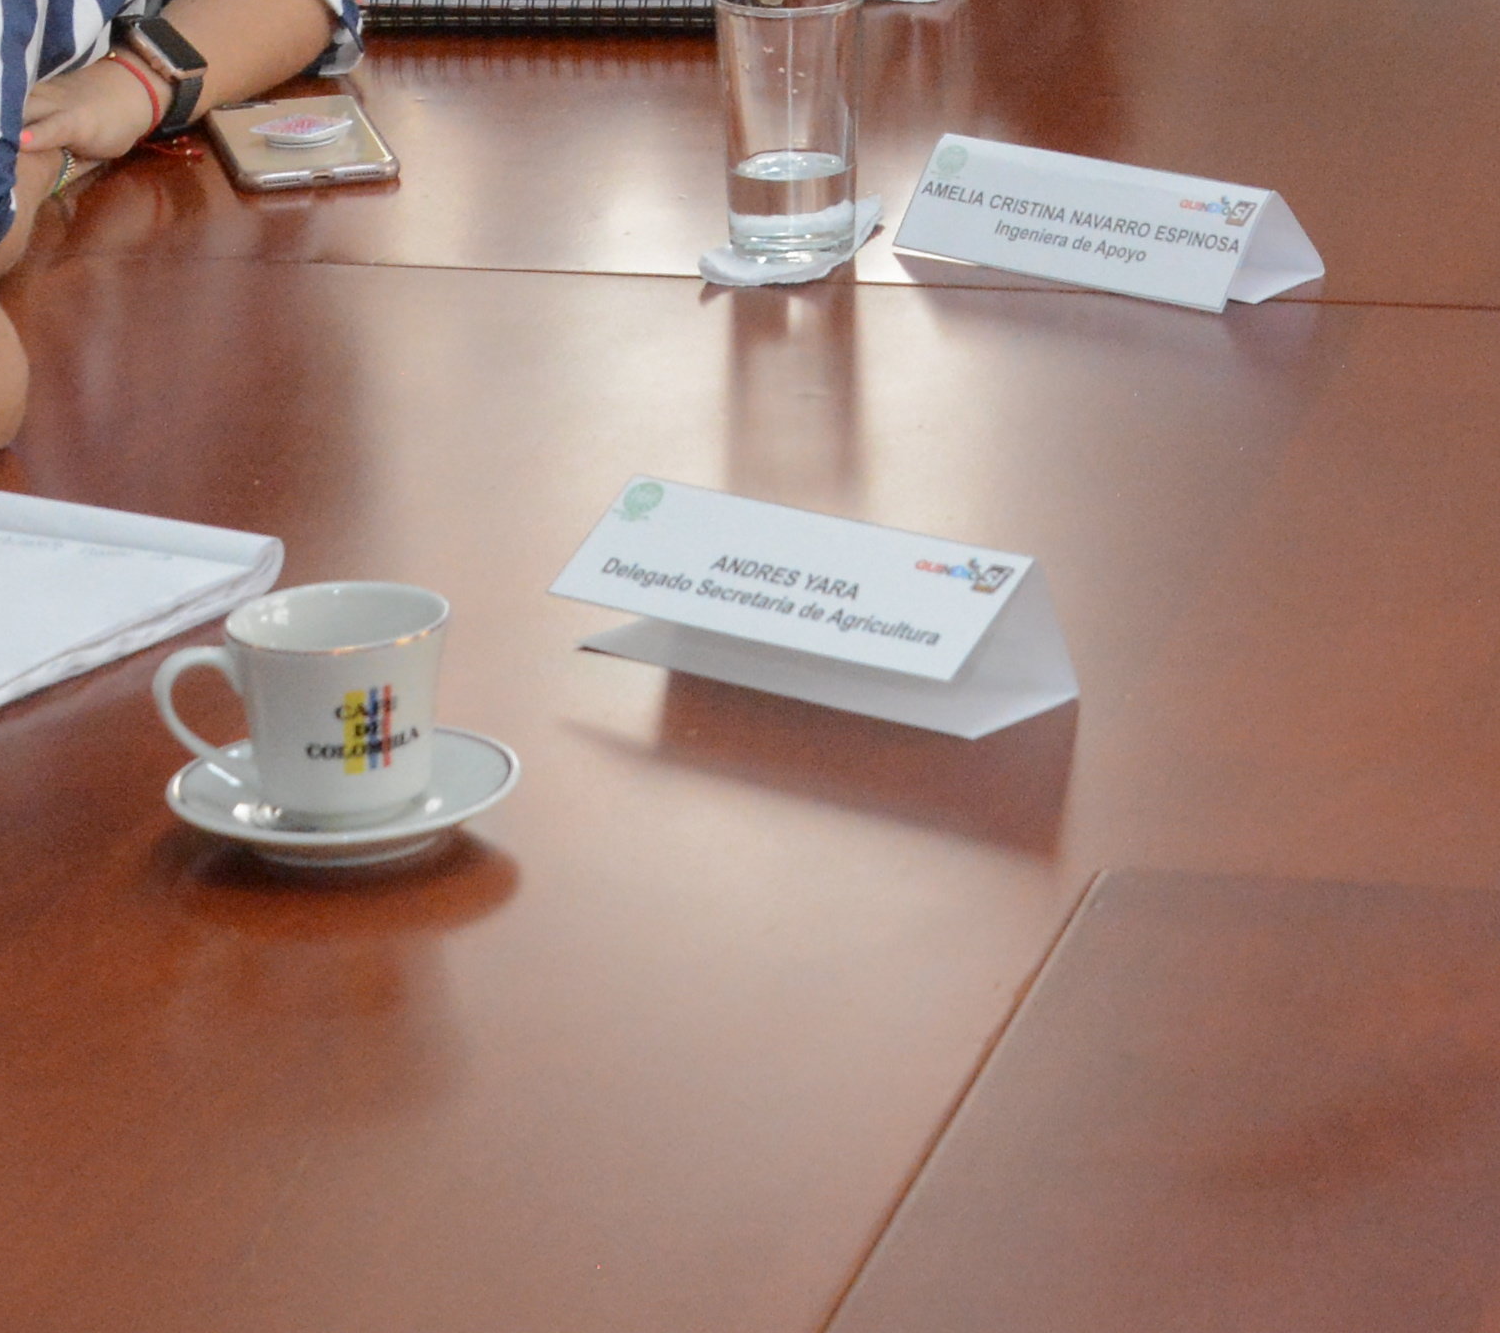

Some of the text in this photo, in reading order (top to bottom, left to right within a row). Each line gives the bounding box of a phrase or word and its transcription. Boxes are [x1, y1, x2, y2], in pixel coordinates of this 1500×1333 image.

[921, 179, 1241, 256] AMELIA CRISTINA NAVARRO ESPINOSA
[993, 221, 1147, 264] Ingeniera de Apoyo
[600, 555, 691, 594] Delegado
[798, 600, 826, 622] de
[825, 607, 942, 648] Agricultura
[710, 554, 861, 601] ANDRES YARA
